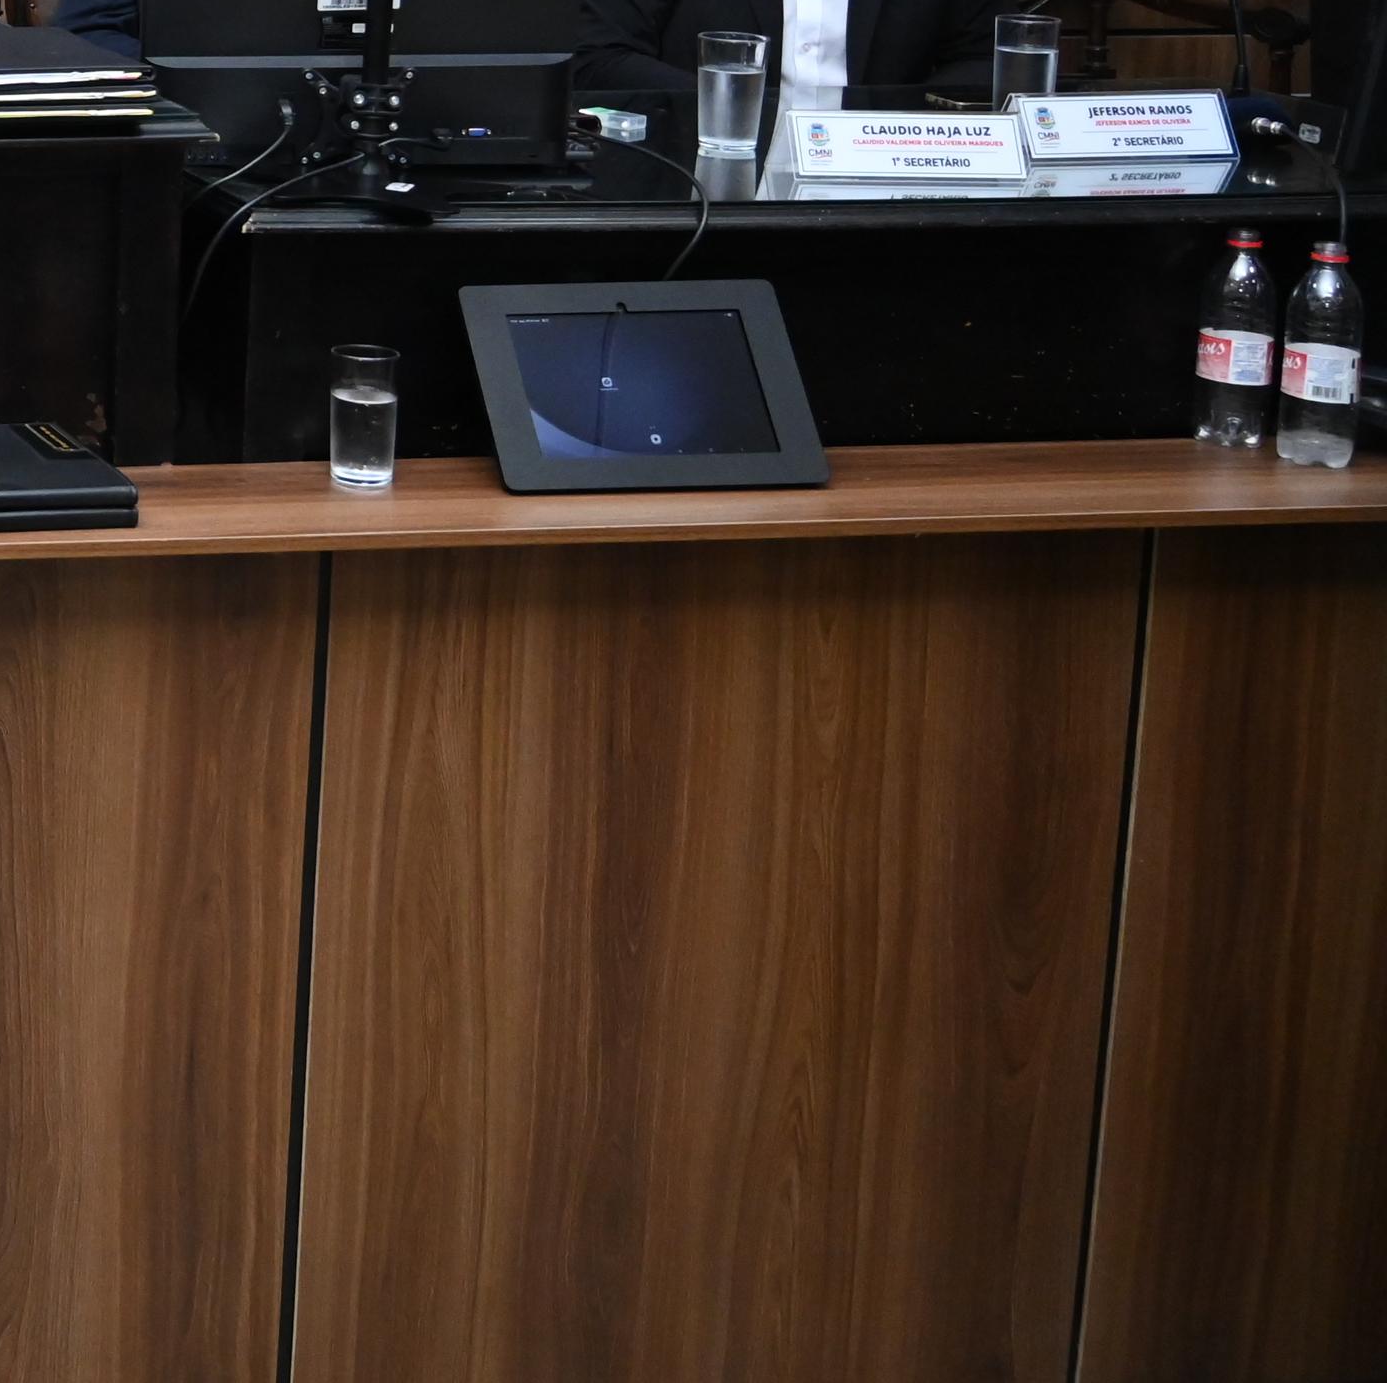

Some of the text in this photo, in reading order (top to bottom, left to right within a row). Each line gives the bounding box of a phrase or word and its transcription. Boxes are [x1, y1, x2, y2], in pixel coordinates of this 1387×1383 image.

[1088, 104, 1193, 119] JEFERSON RAMOS
[1095, 119, 1128, 127] JEFERSON
[1151, 118, 1161, 126] DE
[862, 125, 991, 139] CLAUDIO HAJA LUZ
[1123, 134, 1184, 147] SECRETÁRIO
[903, 156, 971, 168] SECRETÁRIO
